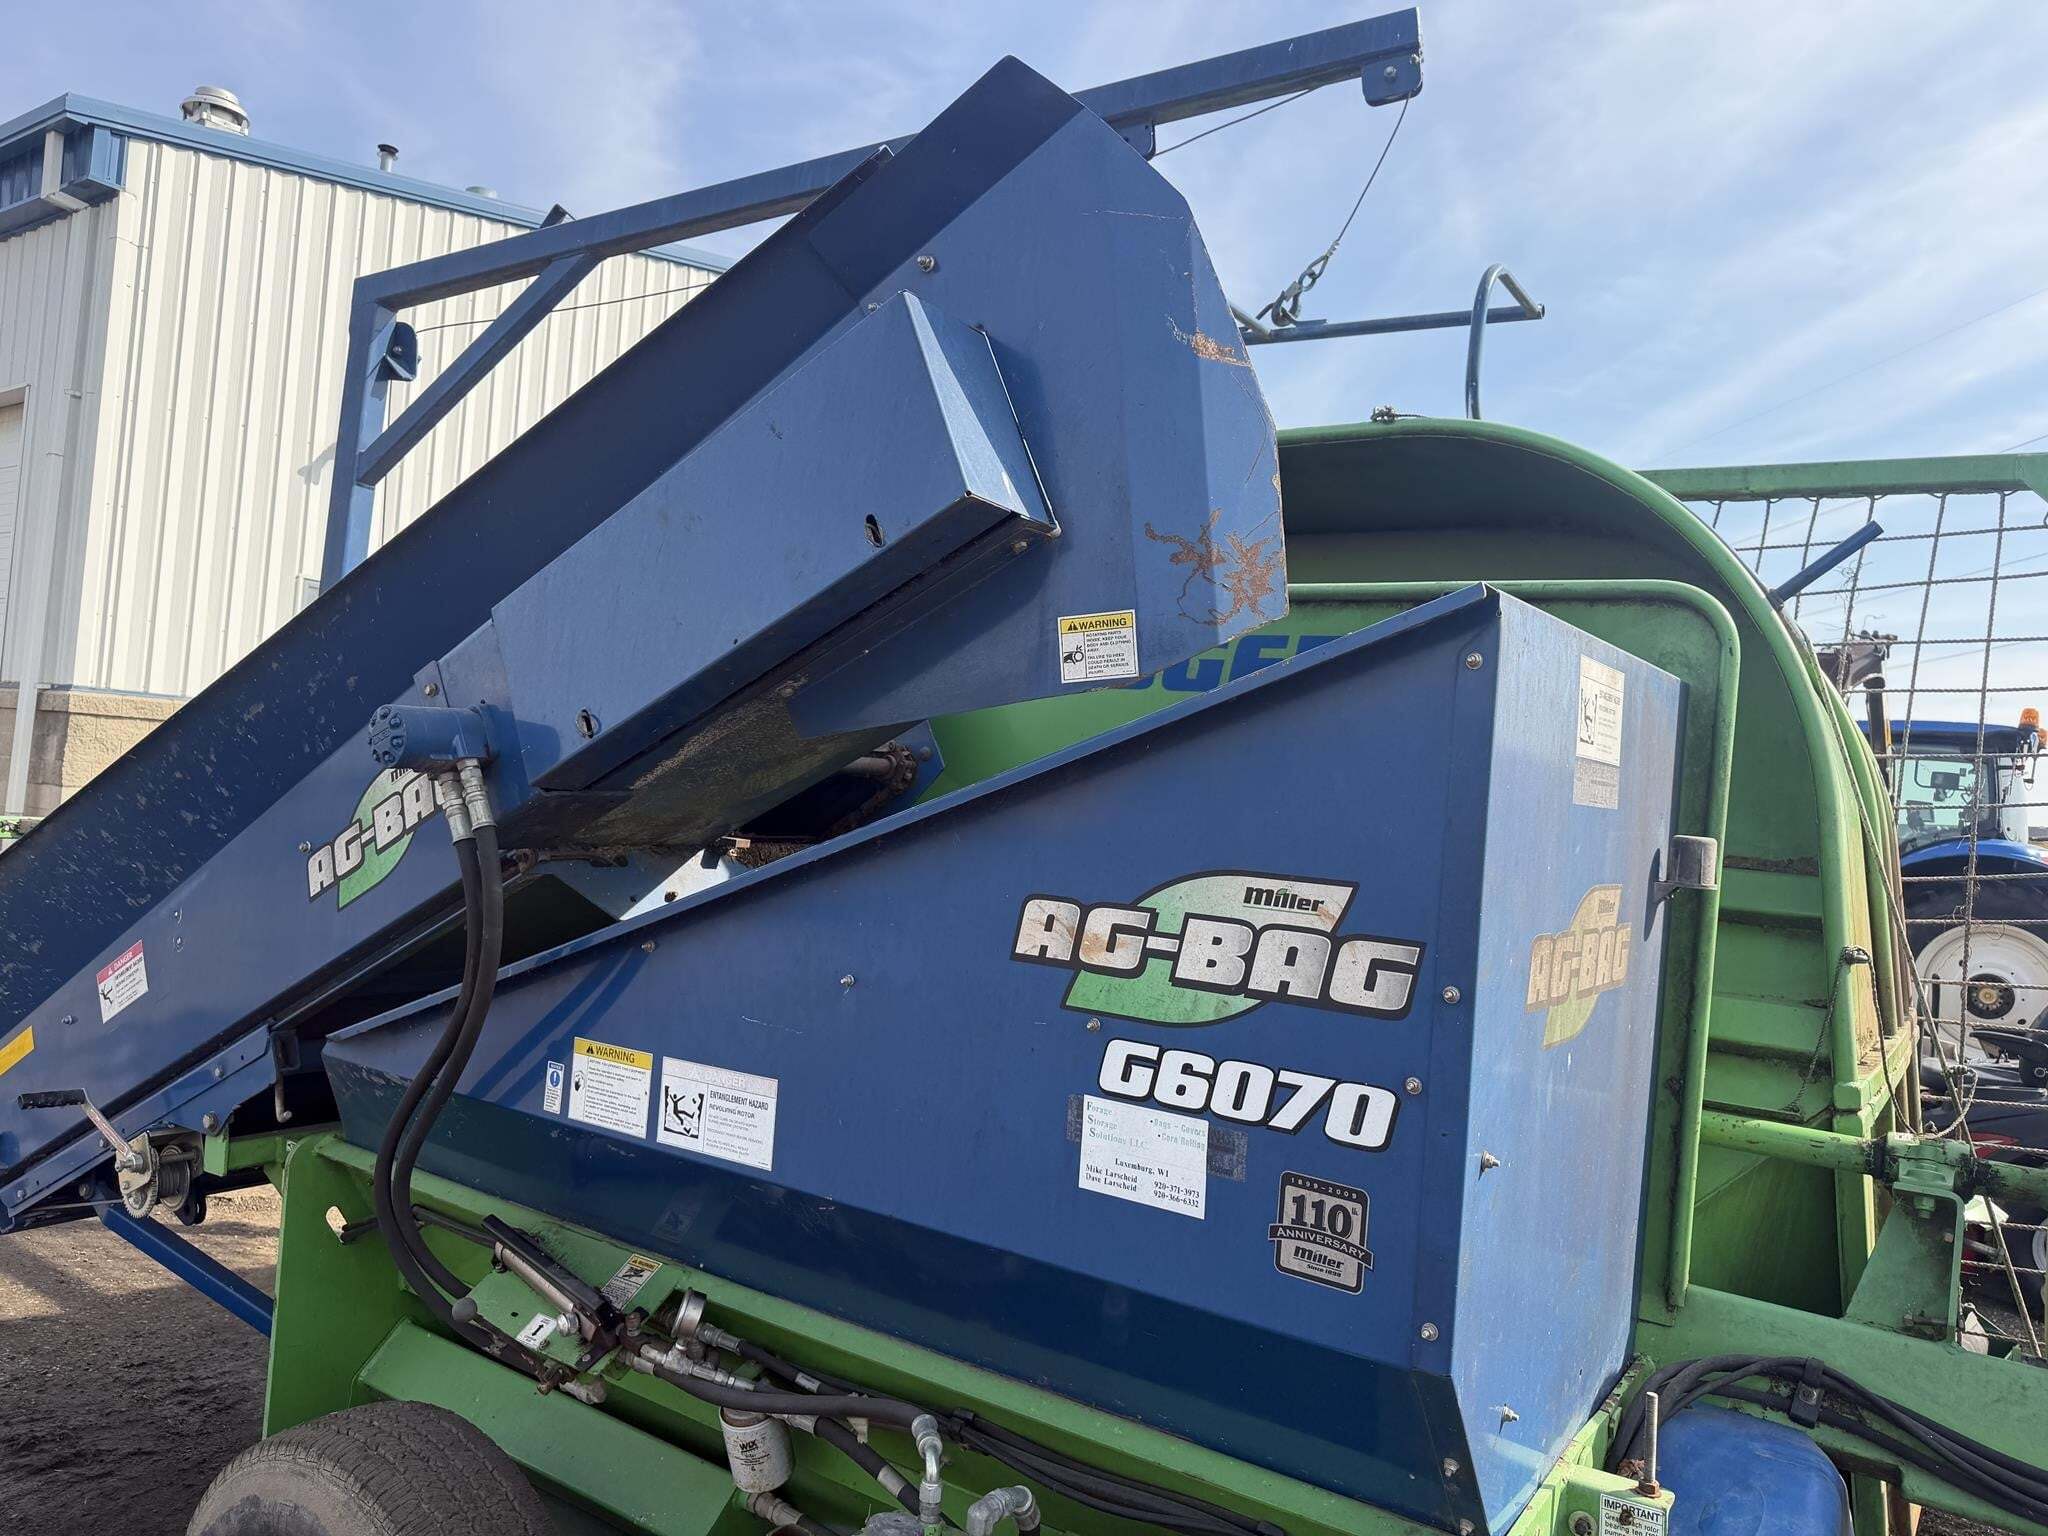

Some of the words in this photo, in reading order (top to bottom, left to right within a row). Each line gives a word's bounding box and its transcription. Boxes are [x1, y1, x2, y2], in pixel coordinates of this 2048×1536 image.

[1079, 617, 1127, 630] WARNING
[1243, 886, 1325, 912] miller
[1013, 897, 1422, 1012] AG-BAG
[1526, 926, 1632, 1006] AG-BAG
[596, 1045, 635, 1064] WARNING
[709, 1090, 748, 1106] ENTANGLEMENT
[748, 1098, 769, 1111] HAZARD
[1099, 1038, 1398, 1149] G6070
[708, 1103, 737, 1116] REVOLVING
[737, 1109, 756, 1120] ROTOR
[1085, 1163, 1102, 1175] Mike
[1105, 1168, 1138, 1184] Larscheid
[1154, 1180, 1200, 1199] 920-371-3973
[1157, 1167, 1169, 1178] WI
[1104, 1177, 1137, 1192] Larscheid
[1153, 1189, 1200, 1208] 920-366-6332
[1276, 1227, 1366, 1259] ANNIVERSARY
[1293, 1245, 1345, 1270] miller
[739, 1438, 759, 1451] WIX
[1603, 1498, 1661, 1522] IMPORTANT
